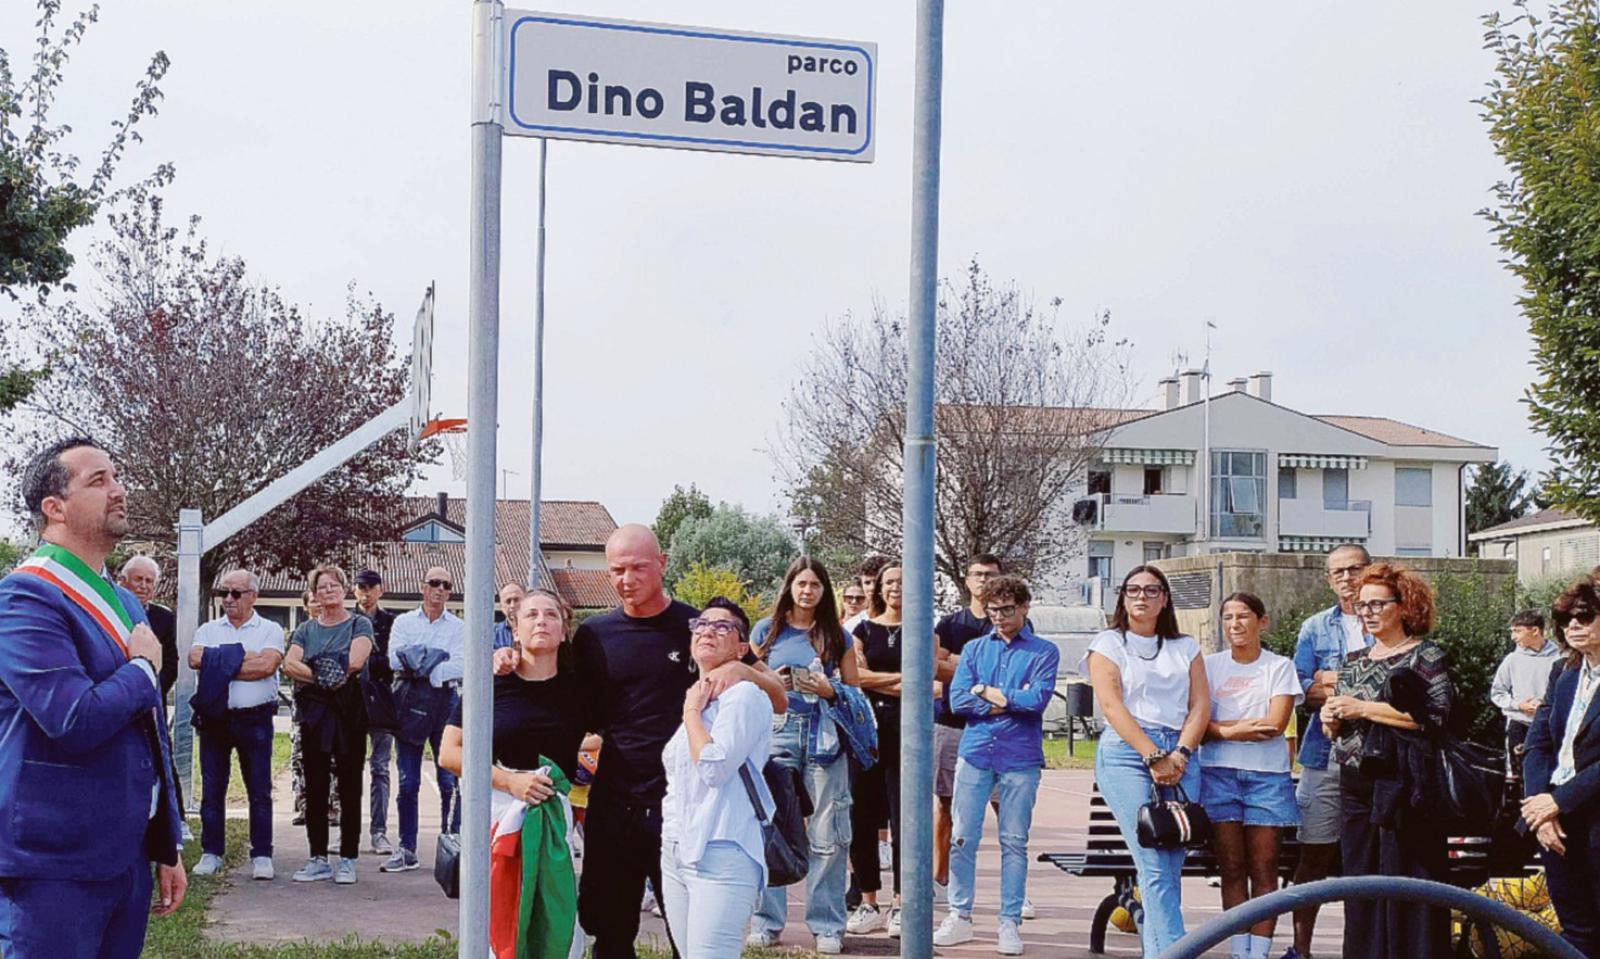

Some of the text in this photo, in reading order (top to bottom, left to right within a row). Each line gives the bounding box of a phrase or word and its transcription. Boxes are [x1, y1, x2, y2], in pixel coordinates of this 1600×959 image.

[788, 54, 858, 75] parco
[547, 70, 857, 134] Dino Baldan
